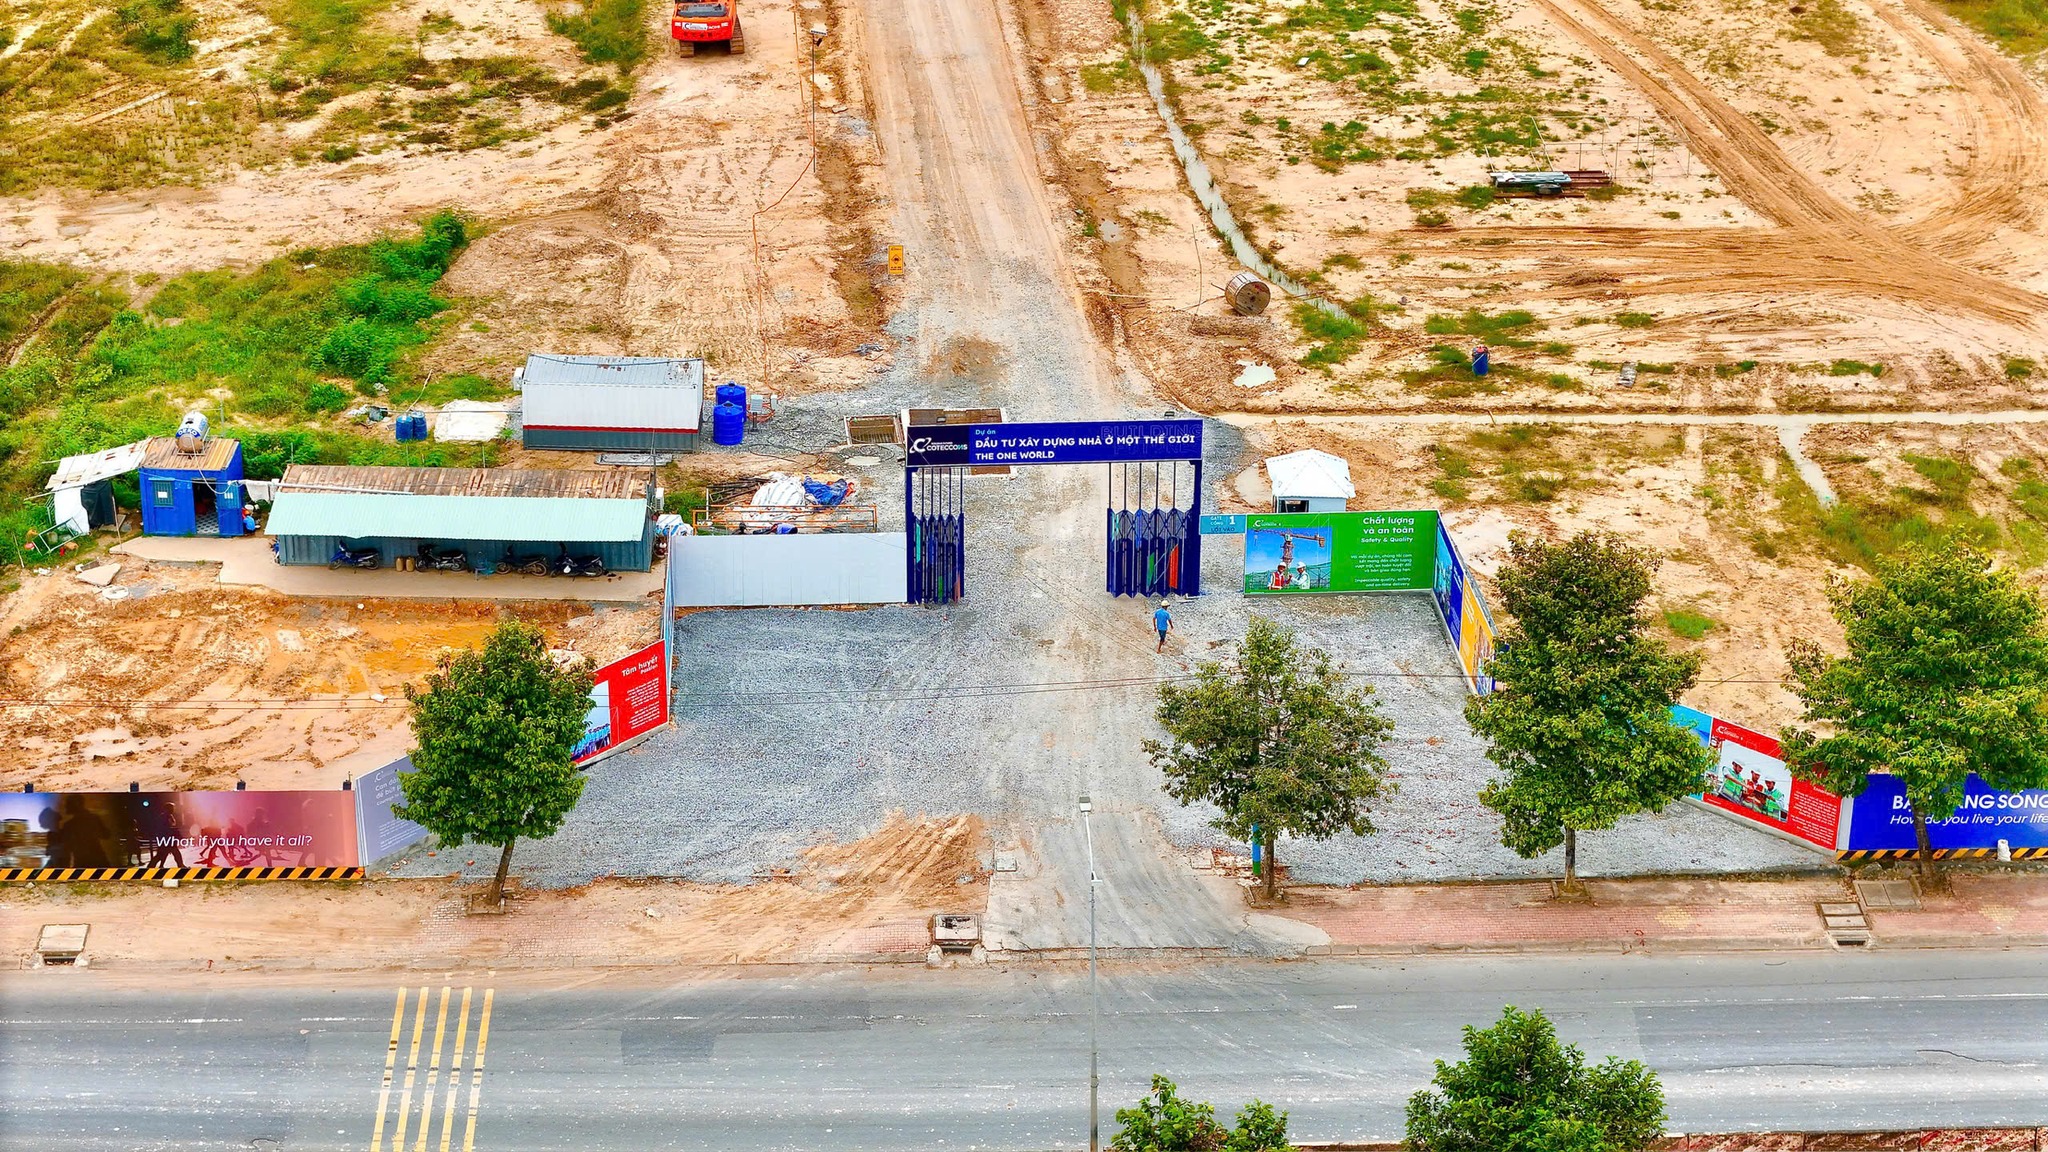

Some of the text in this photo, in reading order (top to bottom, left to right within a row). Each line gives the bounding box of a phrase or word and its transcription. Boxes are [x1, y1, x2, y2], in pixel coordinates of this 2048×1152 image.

[976, 429, 986, 437] Dự
[1001, 438, 1017, 447] TƯ
[1019, 436, 1040, 447] XÂY
[1043, 437, 1075, 448] DỰNG
[1078, 435, 1102, 445] NHÀ
[1105, 434, 1114, 445] Ở
[1116, 434, 1140, 446] MỘT
[1144, 432, 1166, 444] THẾ
[1168, 433, 1195, 444] GIỚI
[976, 450, 1055, 460] THE ONE WORLD
[1229, 515, 1236, 525] 1
[1363, 515, 1415, 525] Chất lượng
[1393, 526, 1414, 534] toàn
[622, 666, 637, 677] Tâm
[1942, 816, 1969, 826] you
[1972, 813, 1995, 824] live
[1995, 815, 2028, 826] your
[156, 835, 312, 849] What if you have it all?
